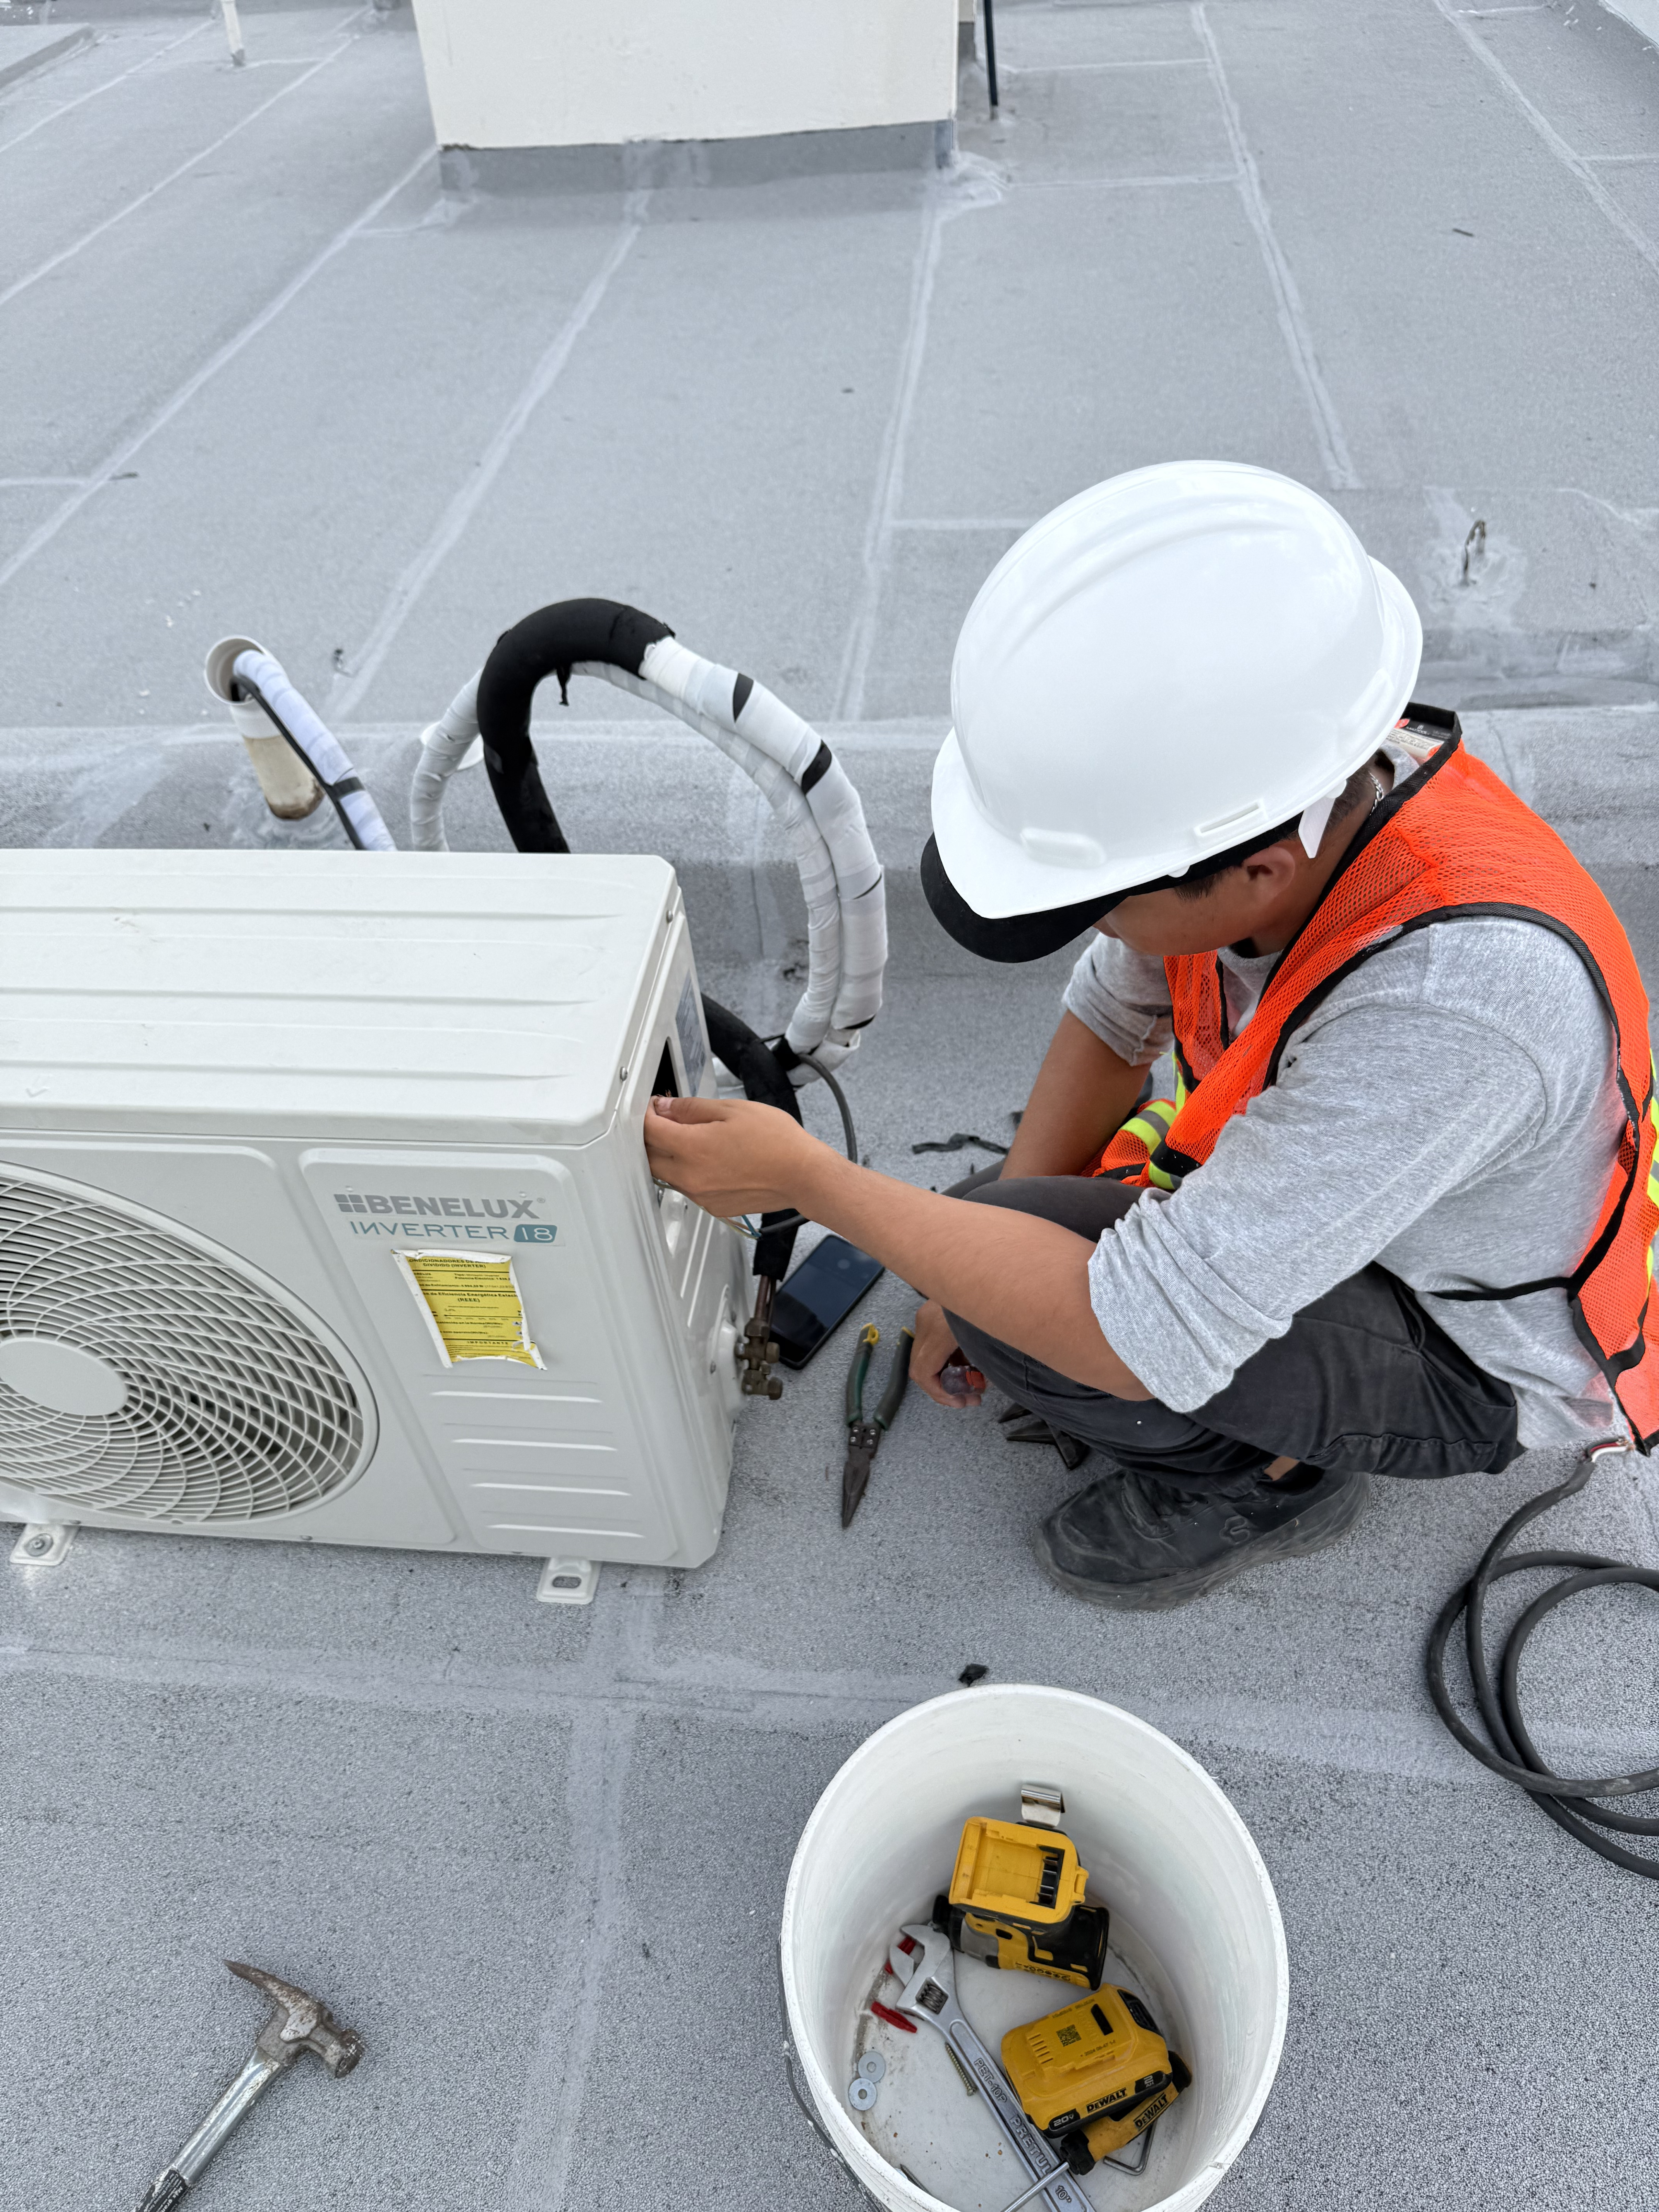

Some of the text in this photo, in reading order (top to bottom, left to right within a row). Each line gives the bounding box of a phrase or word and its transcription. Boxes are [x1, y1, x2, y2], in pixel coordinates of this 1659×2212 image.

[364, 1195, 540, 1219] BENELUX
[350, 1221, 553, 1241] INVERTER 18
[974, 2057, 1007, 2103] PET-10P
[1144, 2075, 1154, 2085] 2
[1010, 2114, 1051, 2175] PRETUL
